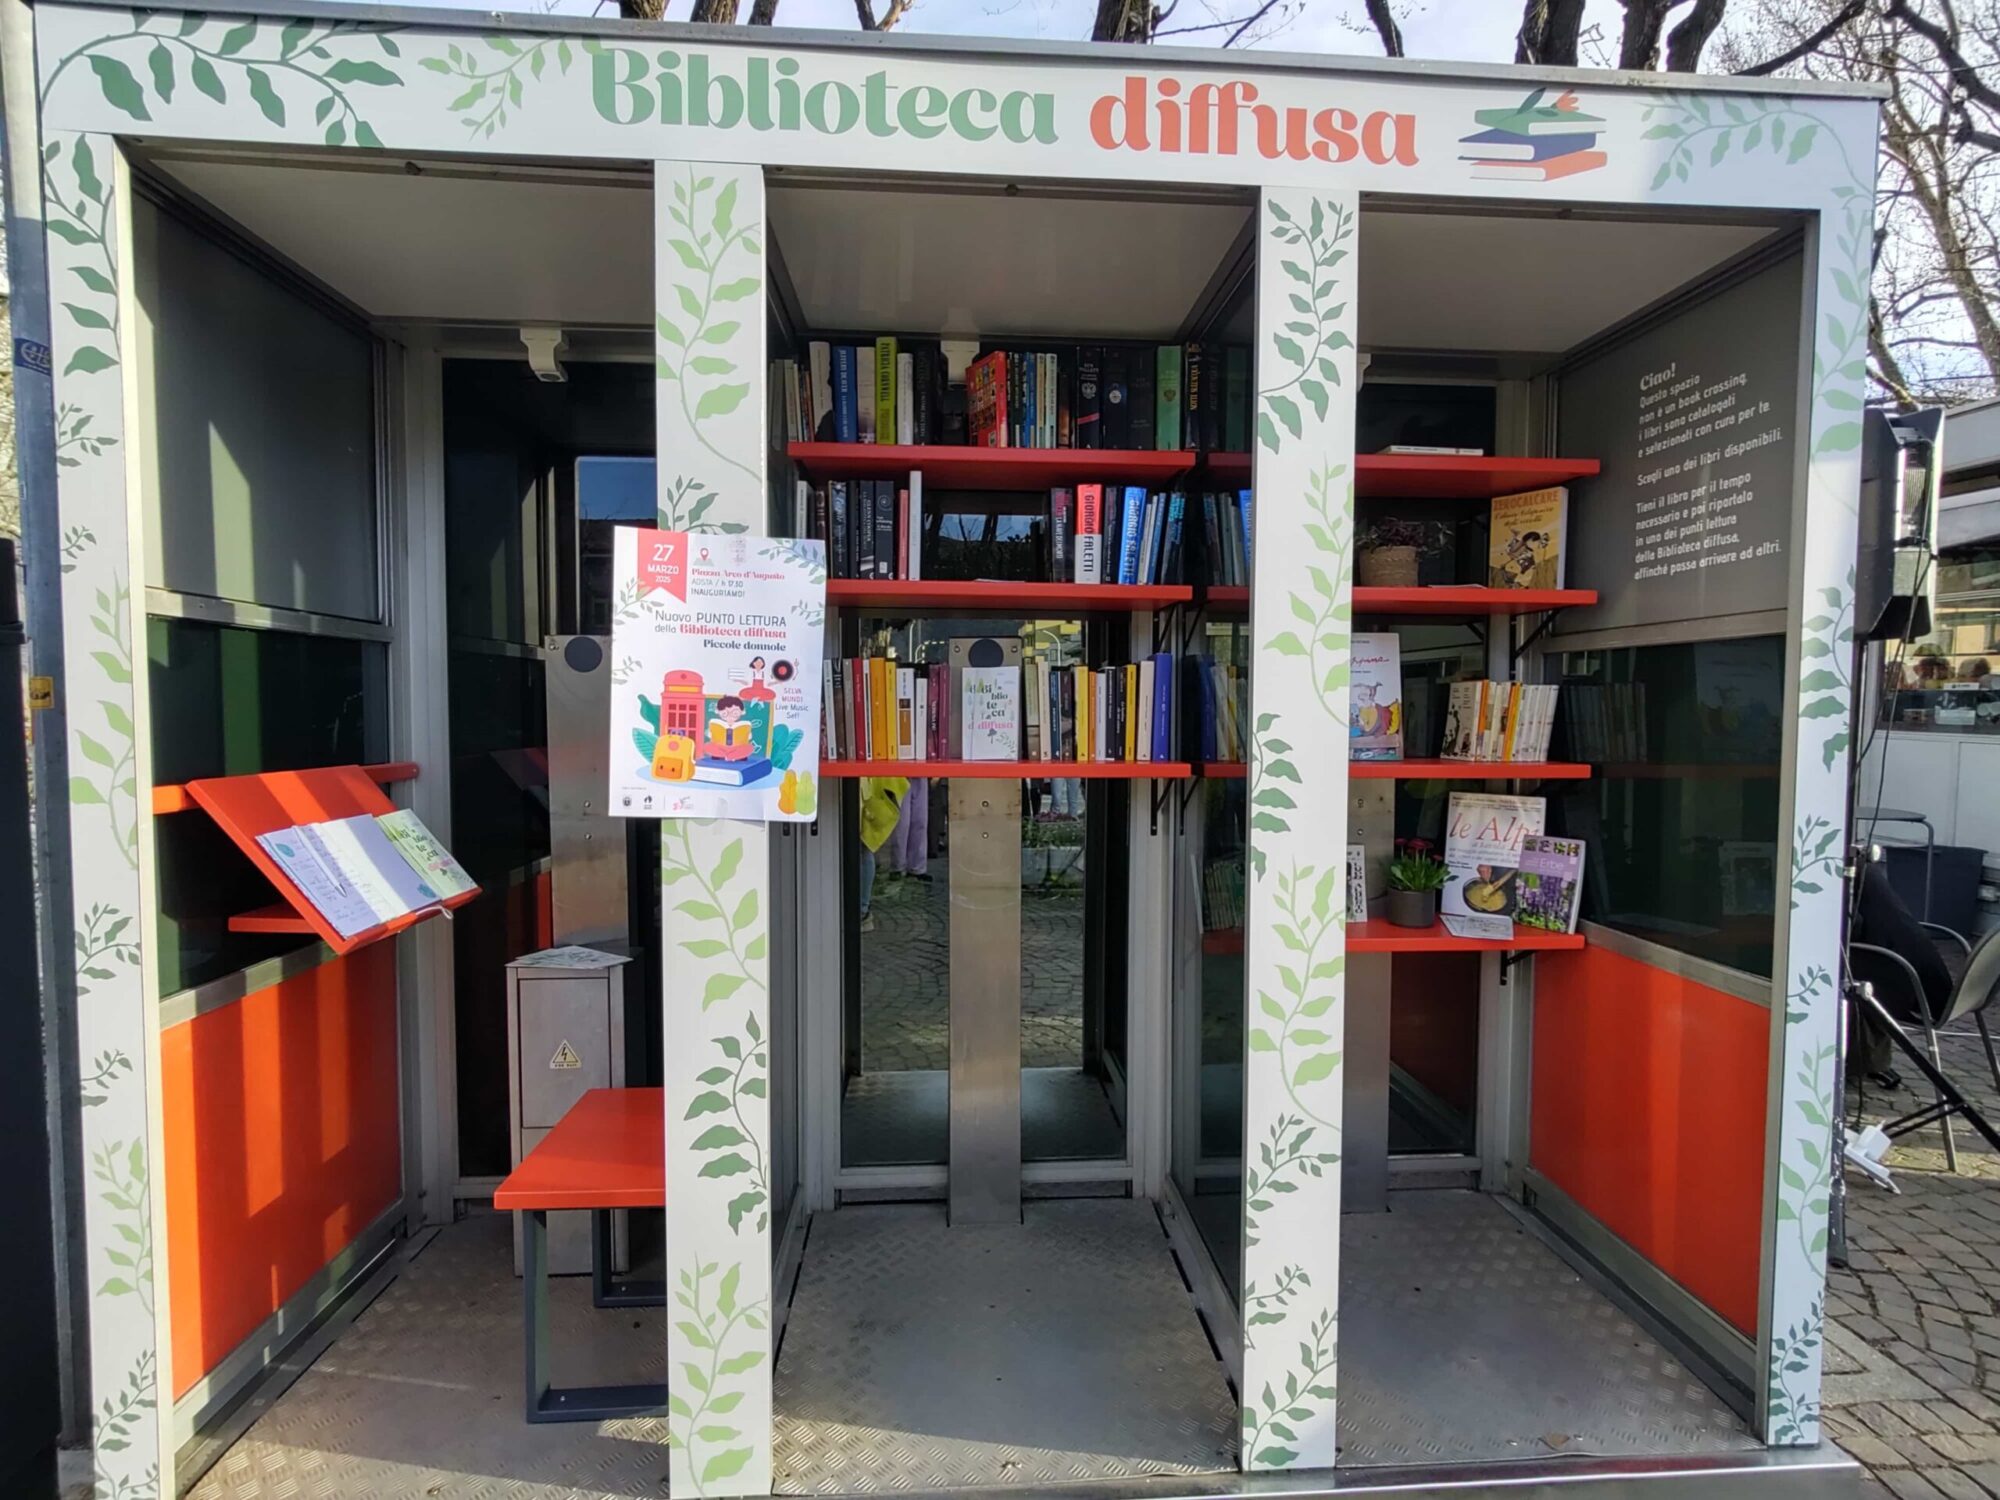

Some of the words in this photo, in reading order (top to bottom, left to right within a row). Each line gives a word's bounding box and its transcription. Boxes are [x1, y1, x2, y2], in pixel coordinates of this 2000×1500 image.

[592, 48, 1059, 145] Biblioteca
[1089, 76, 1420, 166] diffusa
[1640, 362, 1676, 391] Ciao!
[1640, 389, 1667, 409] Questo
[1669, 375, 1700, 396] spazio
[1639, 412, 1655, 425] non
[1657, 407, 1663, 418] è
[1665, 403, 1676, 414] un
[1678, 391, 1701, 409] book
[1644, 422, 1662, 440] libri
[1664, 416, 1686, 432] sono
[1688, 393, 1736, 422] catalogati
[1645, 429, 1693, 456] selezionati
[1695, 424, 1712, 437] con
[1714, 415, 1735, 430] cura
[1738, 406, 1756, 424] per
[1637, 468, 1662, 486] Scegli
[1664, 465, 1681, 477] uno
[1683, 456, 1698, 471] dei
[1700, 448, 1721, 466] libri
[1724, 427, 1783, 458] disponibili.
[1636, 498, 1656, 513] Tieni
[1658, 496, 1665, 508] il
[1667, 491, 1689, 505] libro
[1690, 486, 1707, 501] per
[1709, 480, 1717, 493] il
[1719, 473, 1751, 490] tempo
[1636, 510, 1680, 530] necessario
[1682, 509, 1689, 518] e
[1691, 501, 1706, 519] poi
[1708, 490, 1753, 513] riportalo
[1084, 494, 1094, 534] GIORGIO
[1127, 499, 1139, 537] GIORGIO
[1635, 536, 1644, 547] in
[1645, 533, 1661, 544] uno
[1664, 527, 1678, 540] dei
[1680, 520, 1703, 539] punti
[1706, 515, 1737, 530] lettura
[647, 564, 680, 575] MARZO
[652, 544, 675, 562] 27
[1083, 535, 1094, 573] FALETTI
[1124, 539, 1136, 576] FALETTI
[1635, 550, 1655, 563] della
[1657, 542, 1701, 559] Biblioteca
[1670, 560, 1697, 576] possa
[1699, 553, 1737, 568] arrivare
[1740, 546, 1754, 560] ad
[1755, 539, 1782, 557] altri.
[691, 578, 713, 587] AOSTA
[691, 588, 745, 598] INAUGURIAMO!
[655, 610, 691, 622] Nuovo
[696, 612, 735, 625] PUNTO
[739, 614, 786, 627] LETTURA
[655, 624, 676, 634] della
[680, 624, 741, 637] Biblioteca
[744, 627, 786, 639] diffusa
[703, 639, 741, 650] Piccole
[790, 704, 808, 712] Music
[1449, 812, 1471, 839] le
[1476, 815, 1543, 851] Alpi
